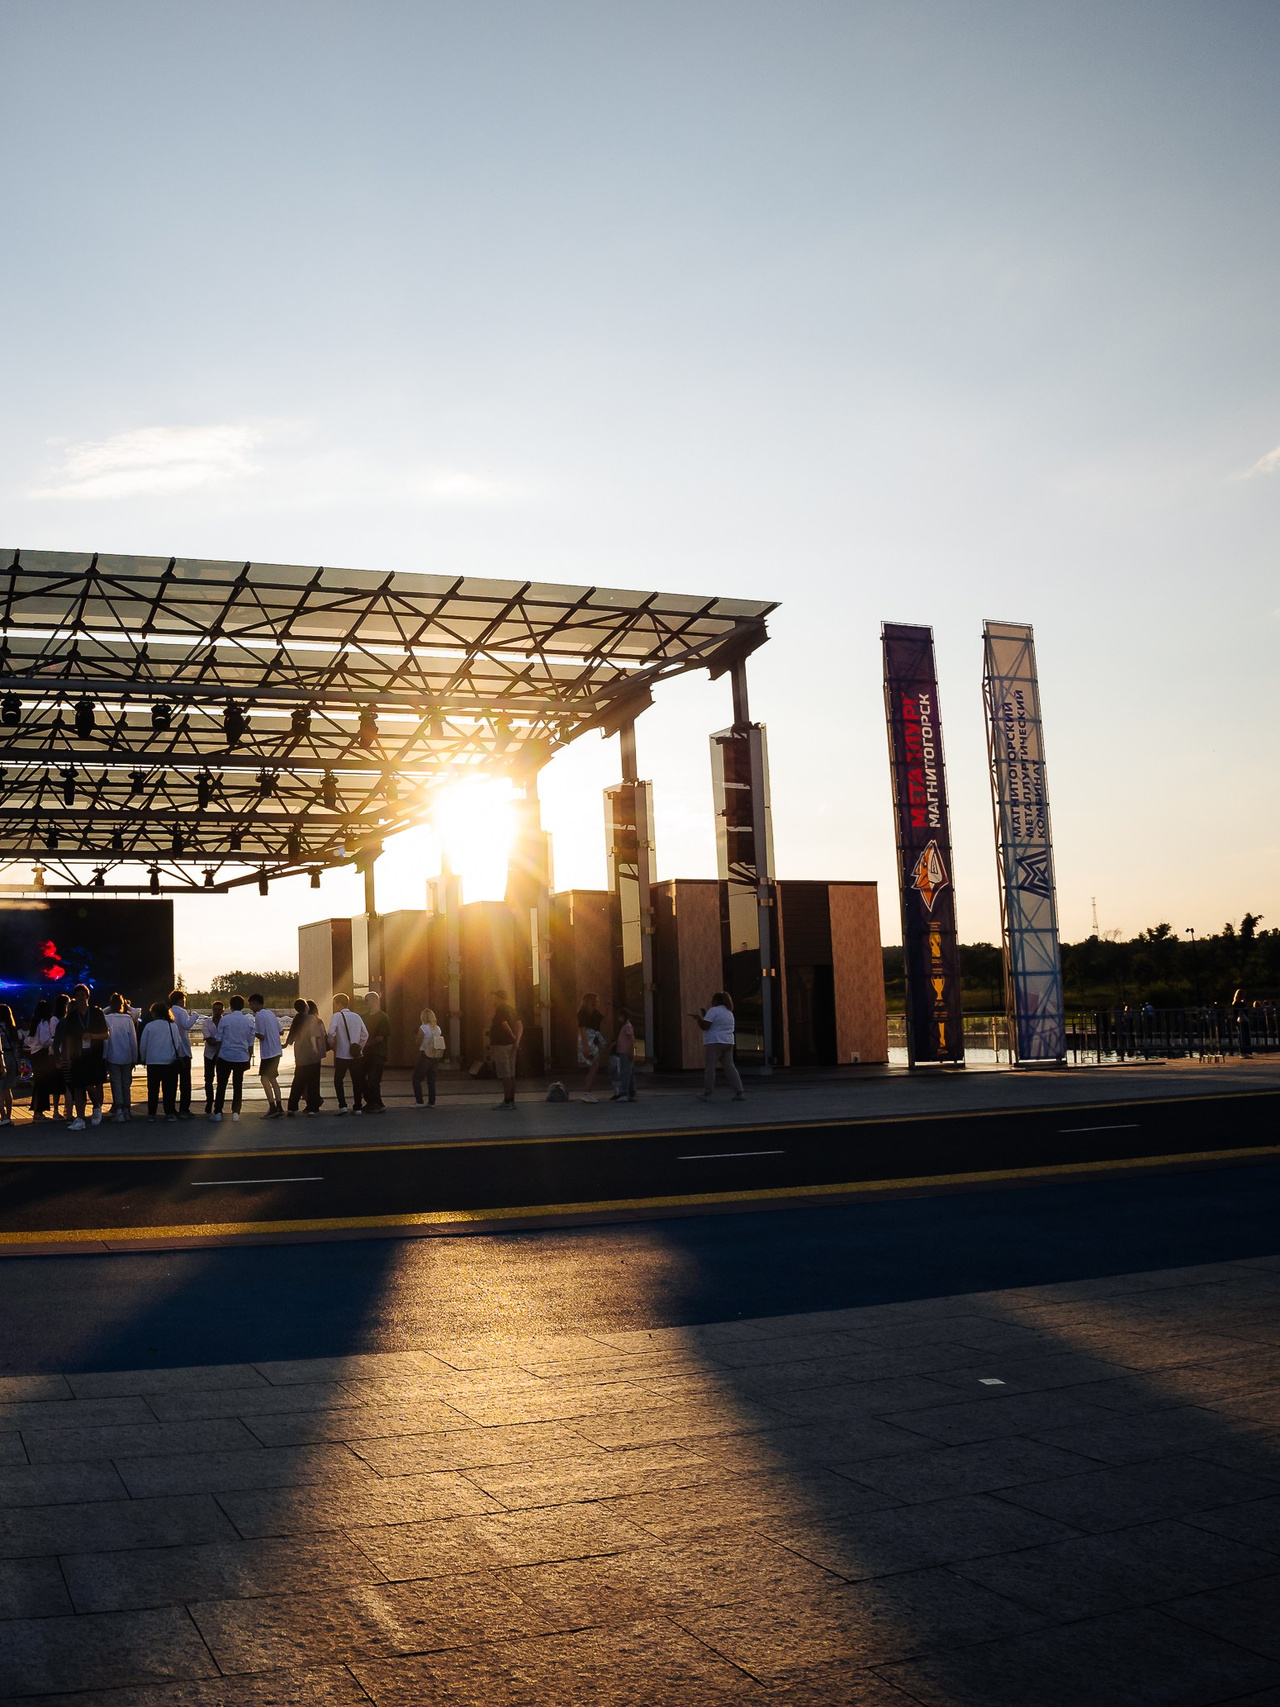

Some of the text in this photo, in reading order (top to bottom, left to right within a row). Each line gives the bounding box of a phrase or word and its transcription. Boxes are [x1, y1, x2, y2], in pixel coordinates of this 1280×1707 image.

[901, 691, 928, 828] МЕТАЛЛУРГ
[918, 692, 941, 828] МАГНИТОГОРСК
[1002, 702, 1022, 838] МАГНИТОГОРСКИЙ
[1013, 689, 1034, 838] МЕТАЛЛУРГИЧЕСКИЙ
[1031, 759, 1046, 839] КОМБИНАТ
